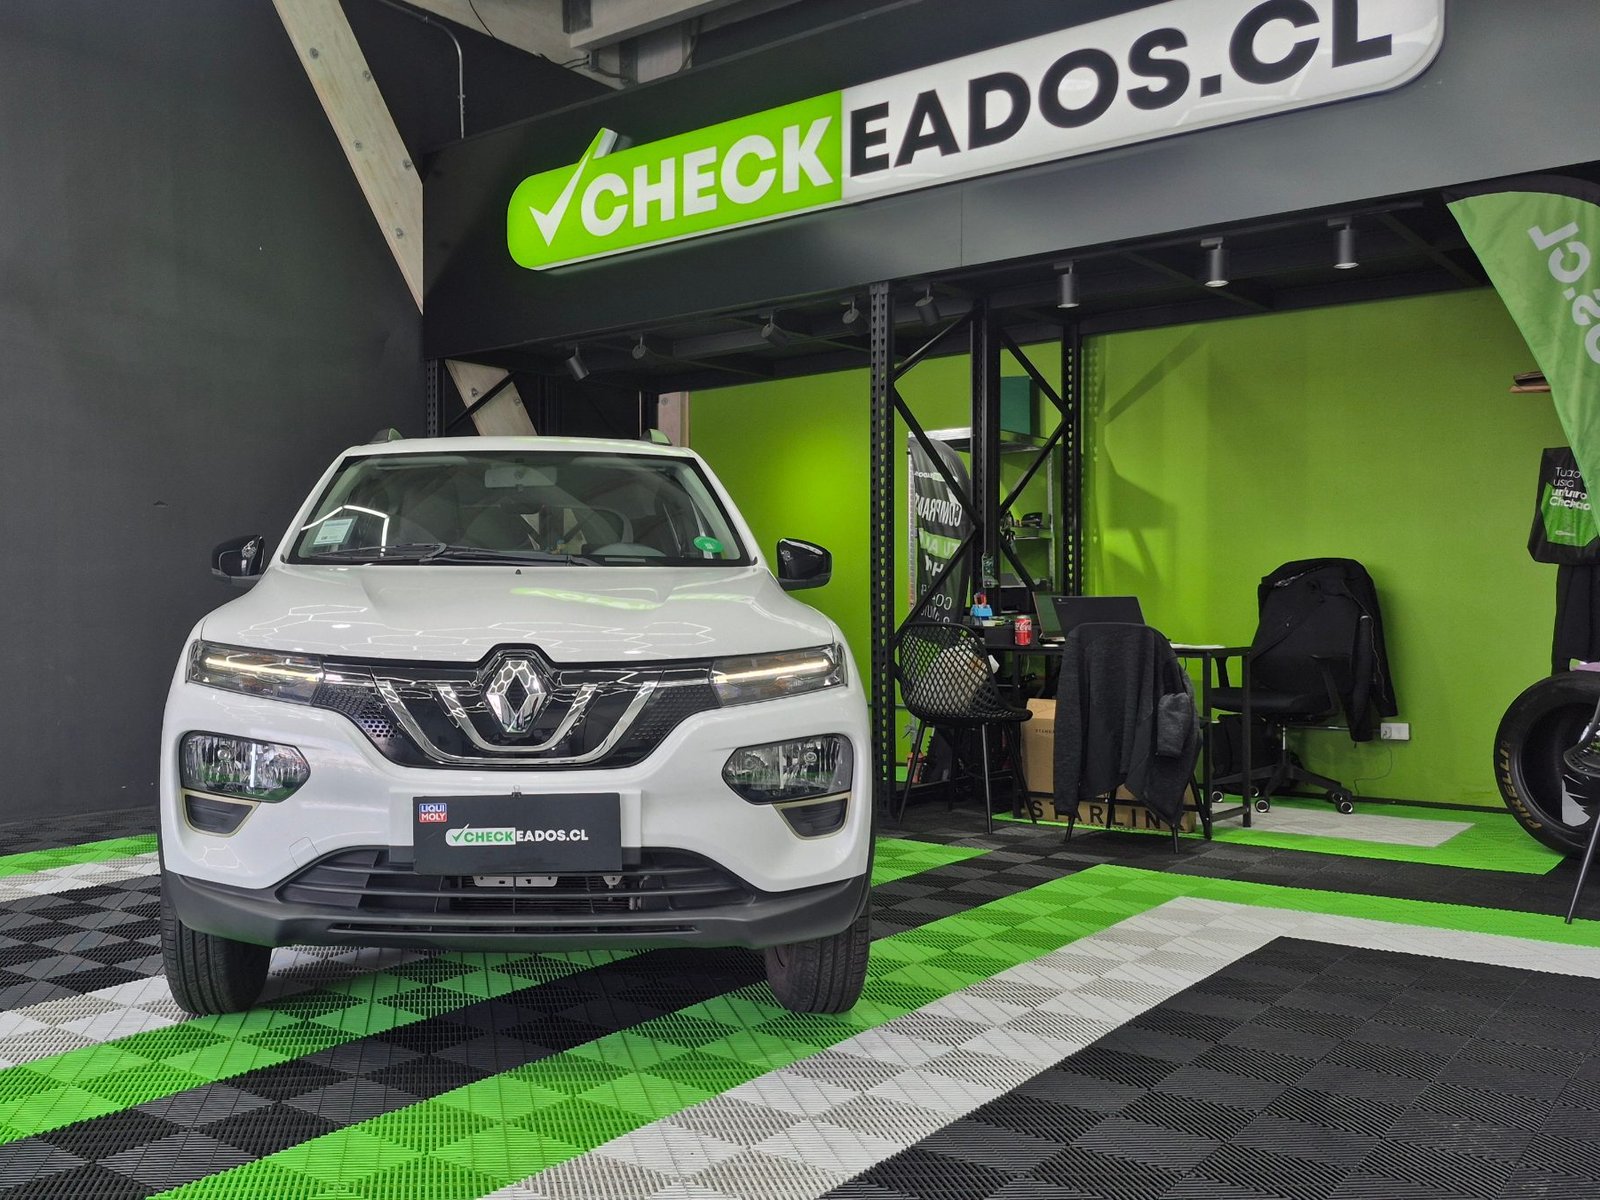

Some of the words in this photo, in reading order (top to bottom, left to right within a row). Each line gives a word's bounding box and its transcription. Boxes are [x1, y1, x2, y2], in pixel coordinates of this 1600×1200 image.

[1499, 748, 1543, 829] PIRELLI
[421, 804, 445, 813] LIQUI
[421, 812, 446, 821] MOLY
[464, 829, 589, 843] CHECKEADOS.CL
